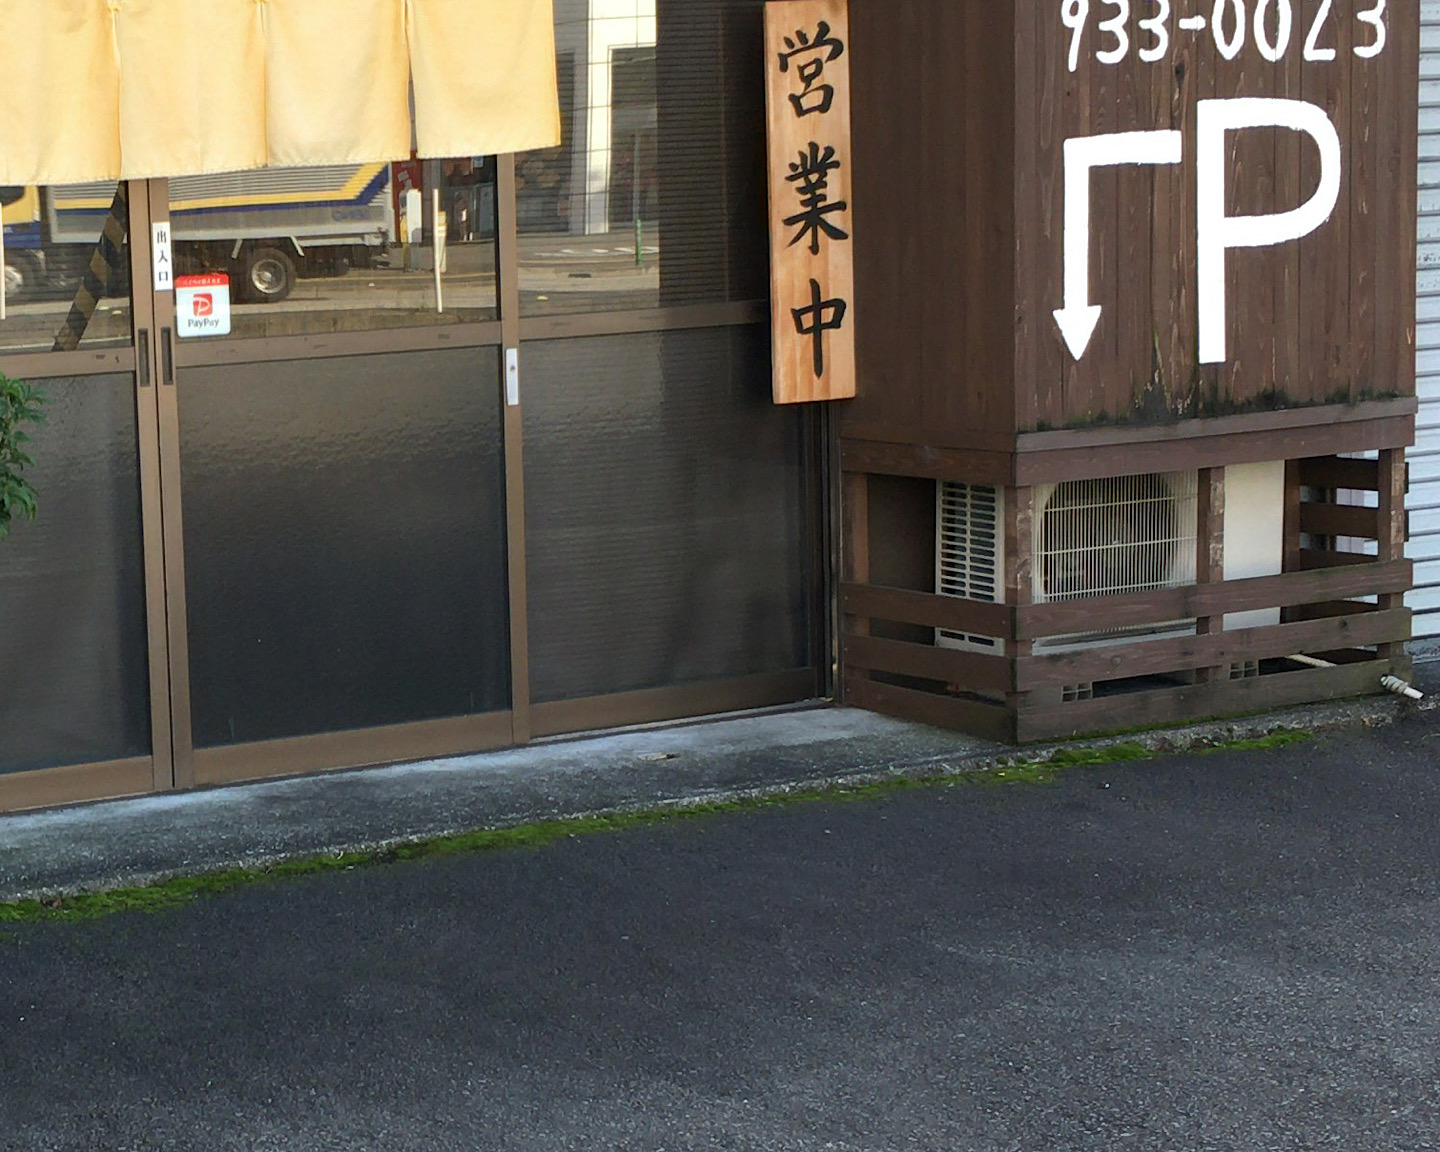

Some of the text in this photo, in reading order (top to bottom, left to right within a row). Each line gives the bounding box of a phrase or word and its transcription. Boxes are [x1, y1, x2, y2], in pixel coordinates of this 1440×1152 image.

[156, 229, 170, 282] 出入口
[778, 20, 850, 380] 営業中
[1197, 97, 1342, 365] P
[187, 317, 220, 329] PayPay
